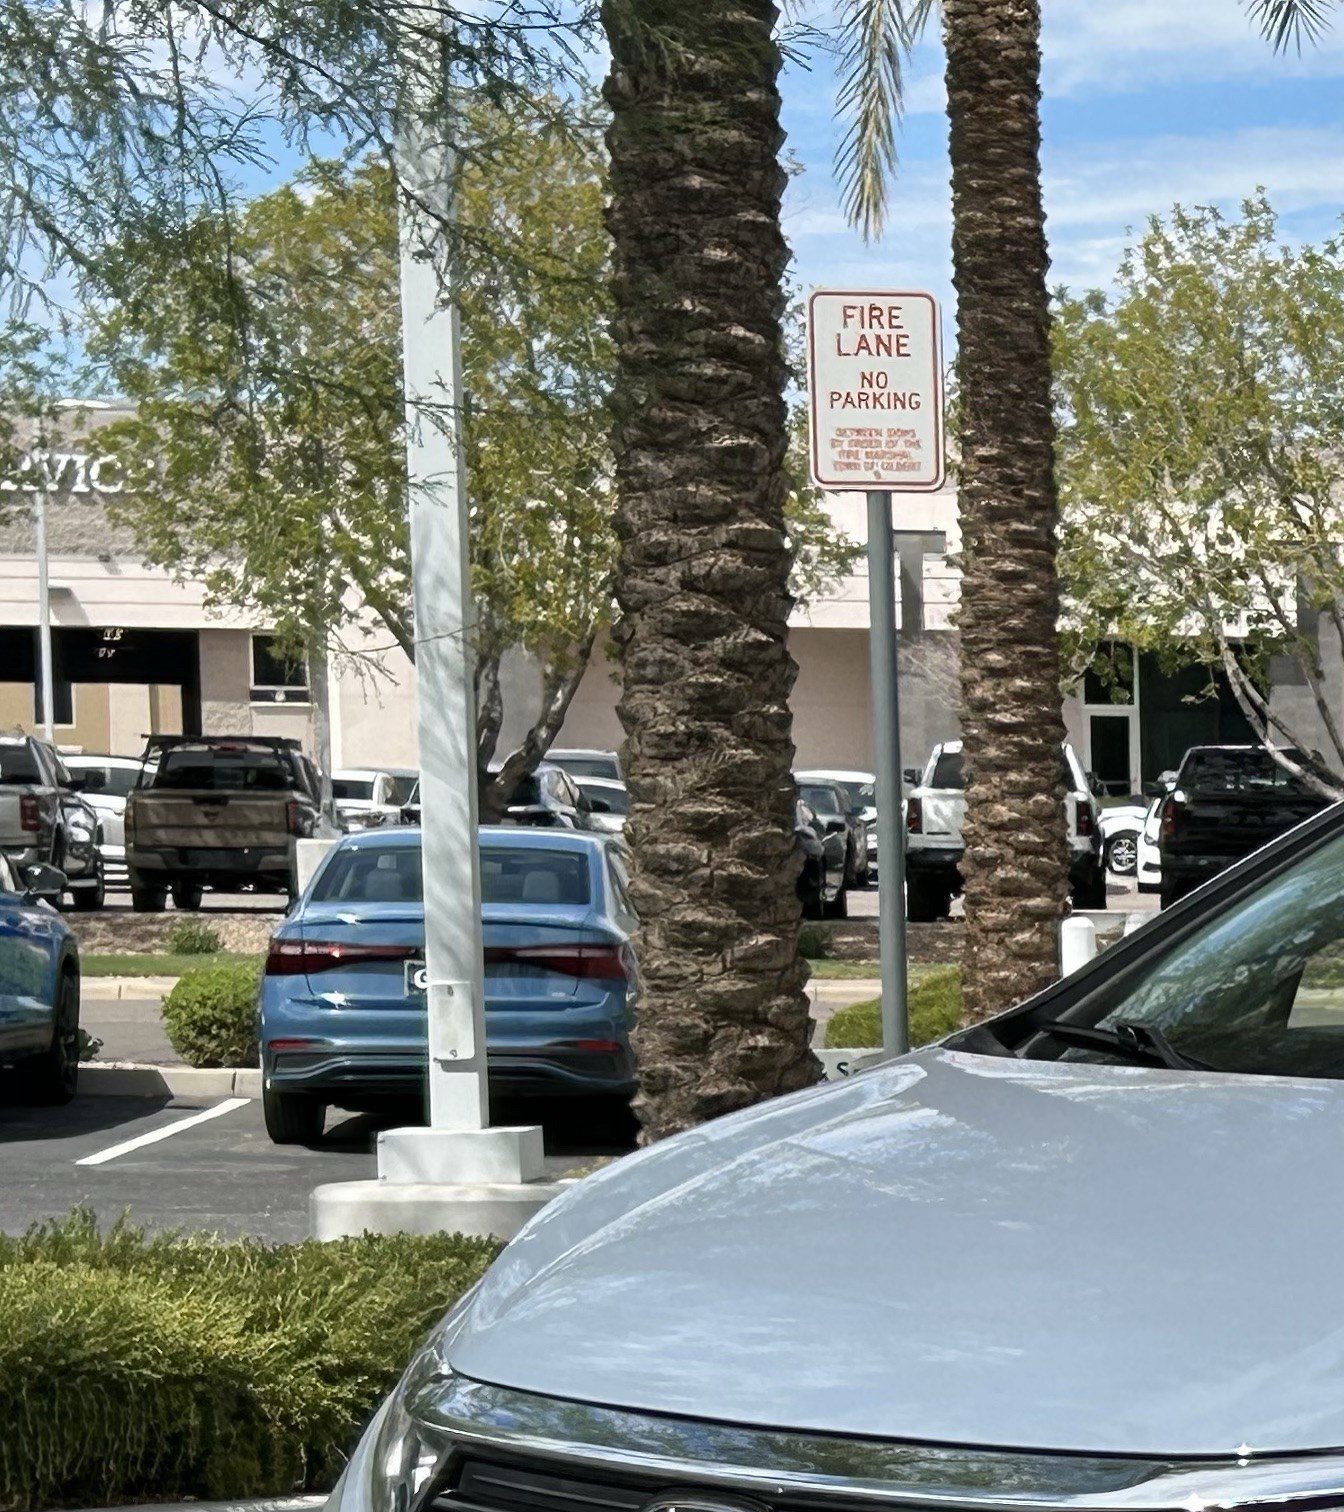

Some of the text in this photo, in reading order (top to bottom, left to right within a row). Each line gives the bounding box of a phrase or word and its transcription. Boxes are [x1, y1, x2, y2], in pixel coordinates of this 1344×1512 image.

[842, 304, 904, 329] FIRE
[836, 333, 911, 357] LANE
[860, 371, 888, 389] NO
[829, 391, 921, 410] PARKING
